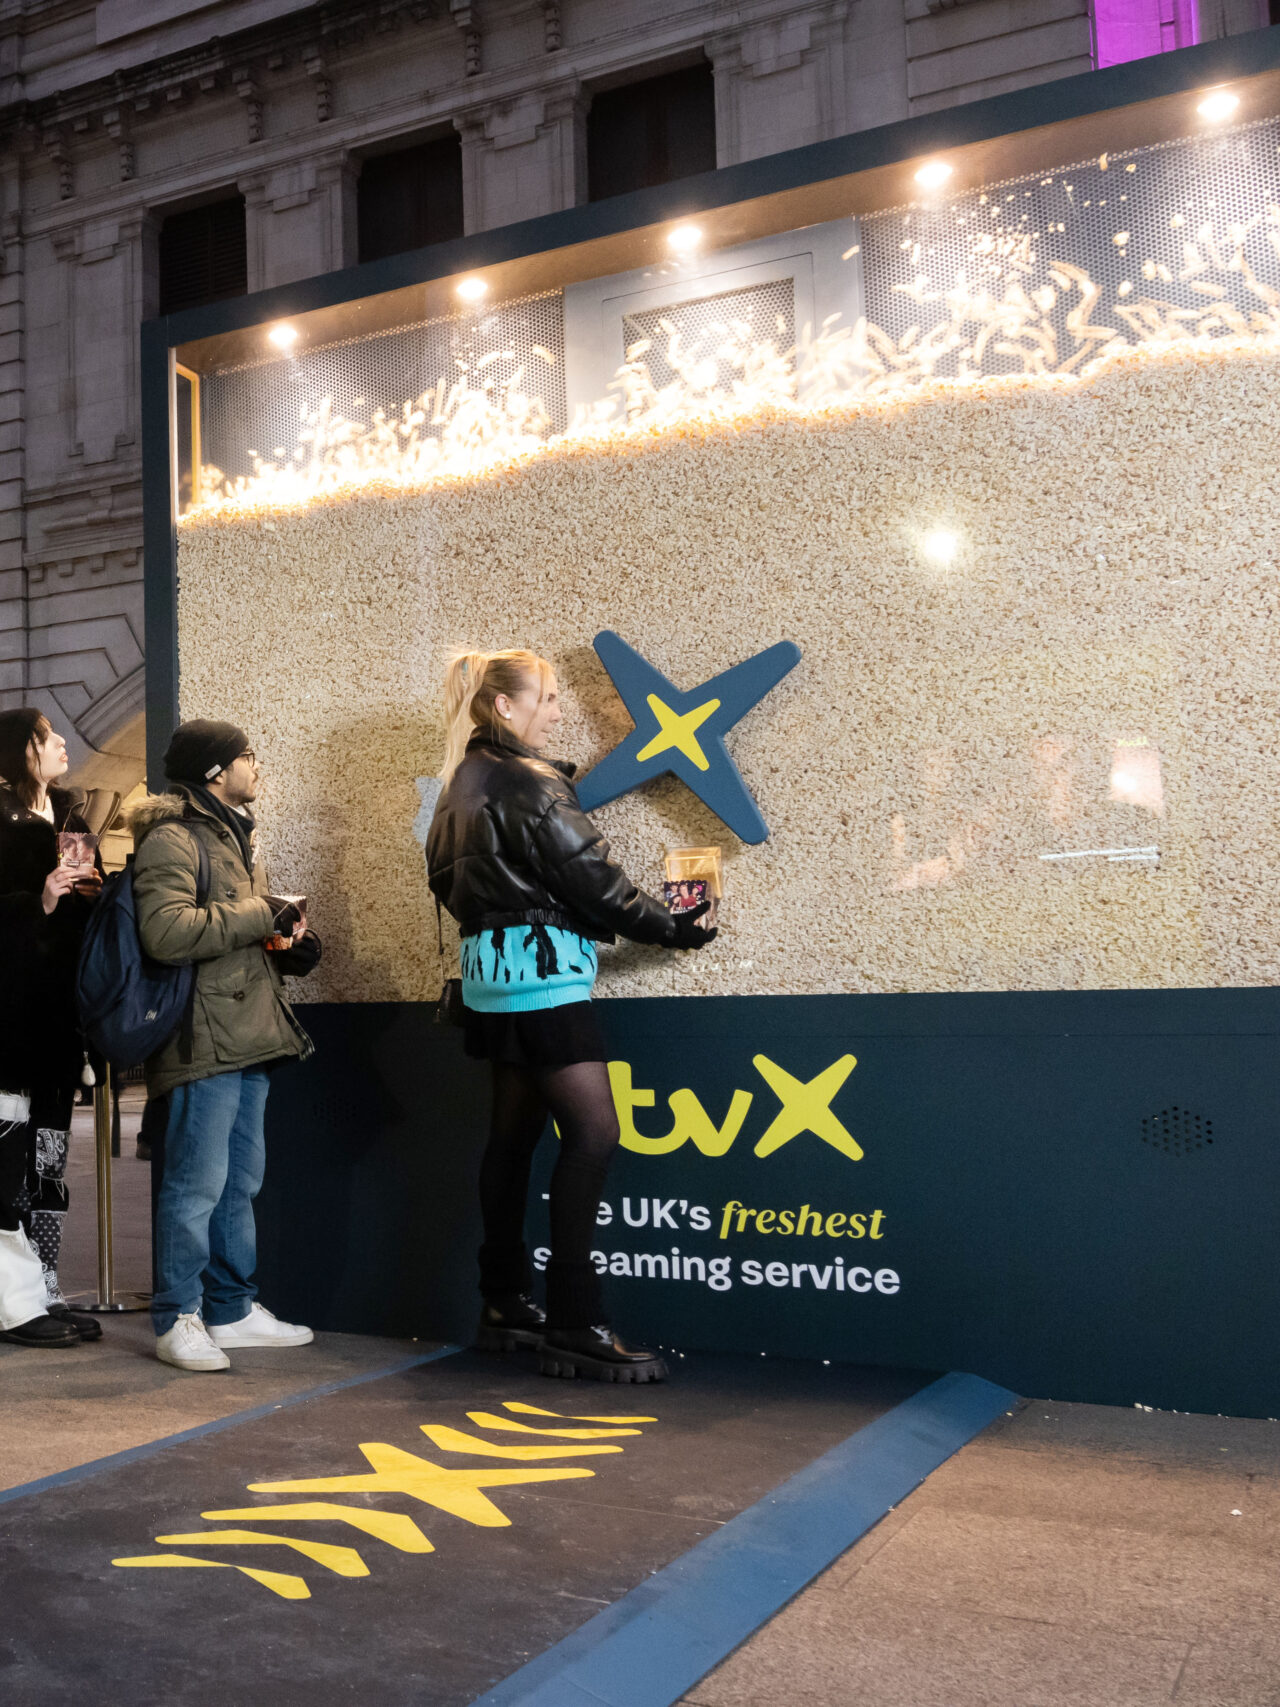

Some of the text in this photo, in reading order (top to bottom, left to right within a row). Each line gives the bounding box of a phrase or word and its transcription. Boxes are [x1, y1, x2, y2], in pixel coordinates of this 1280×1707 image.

[554, 1054, 864, 1161] tvX
[623, 1197, 711, 1230] UK's
[720, 1201, 886, 1240] freshest
[533, 1247, 900, 1294] seaming service
